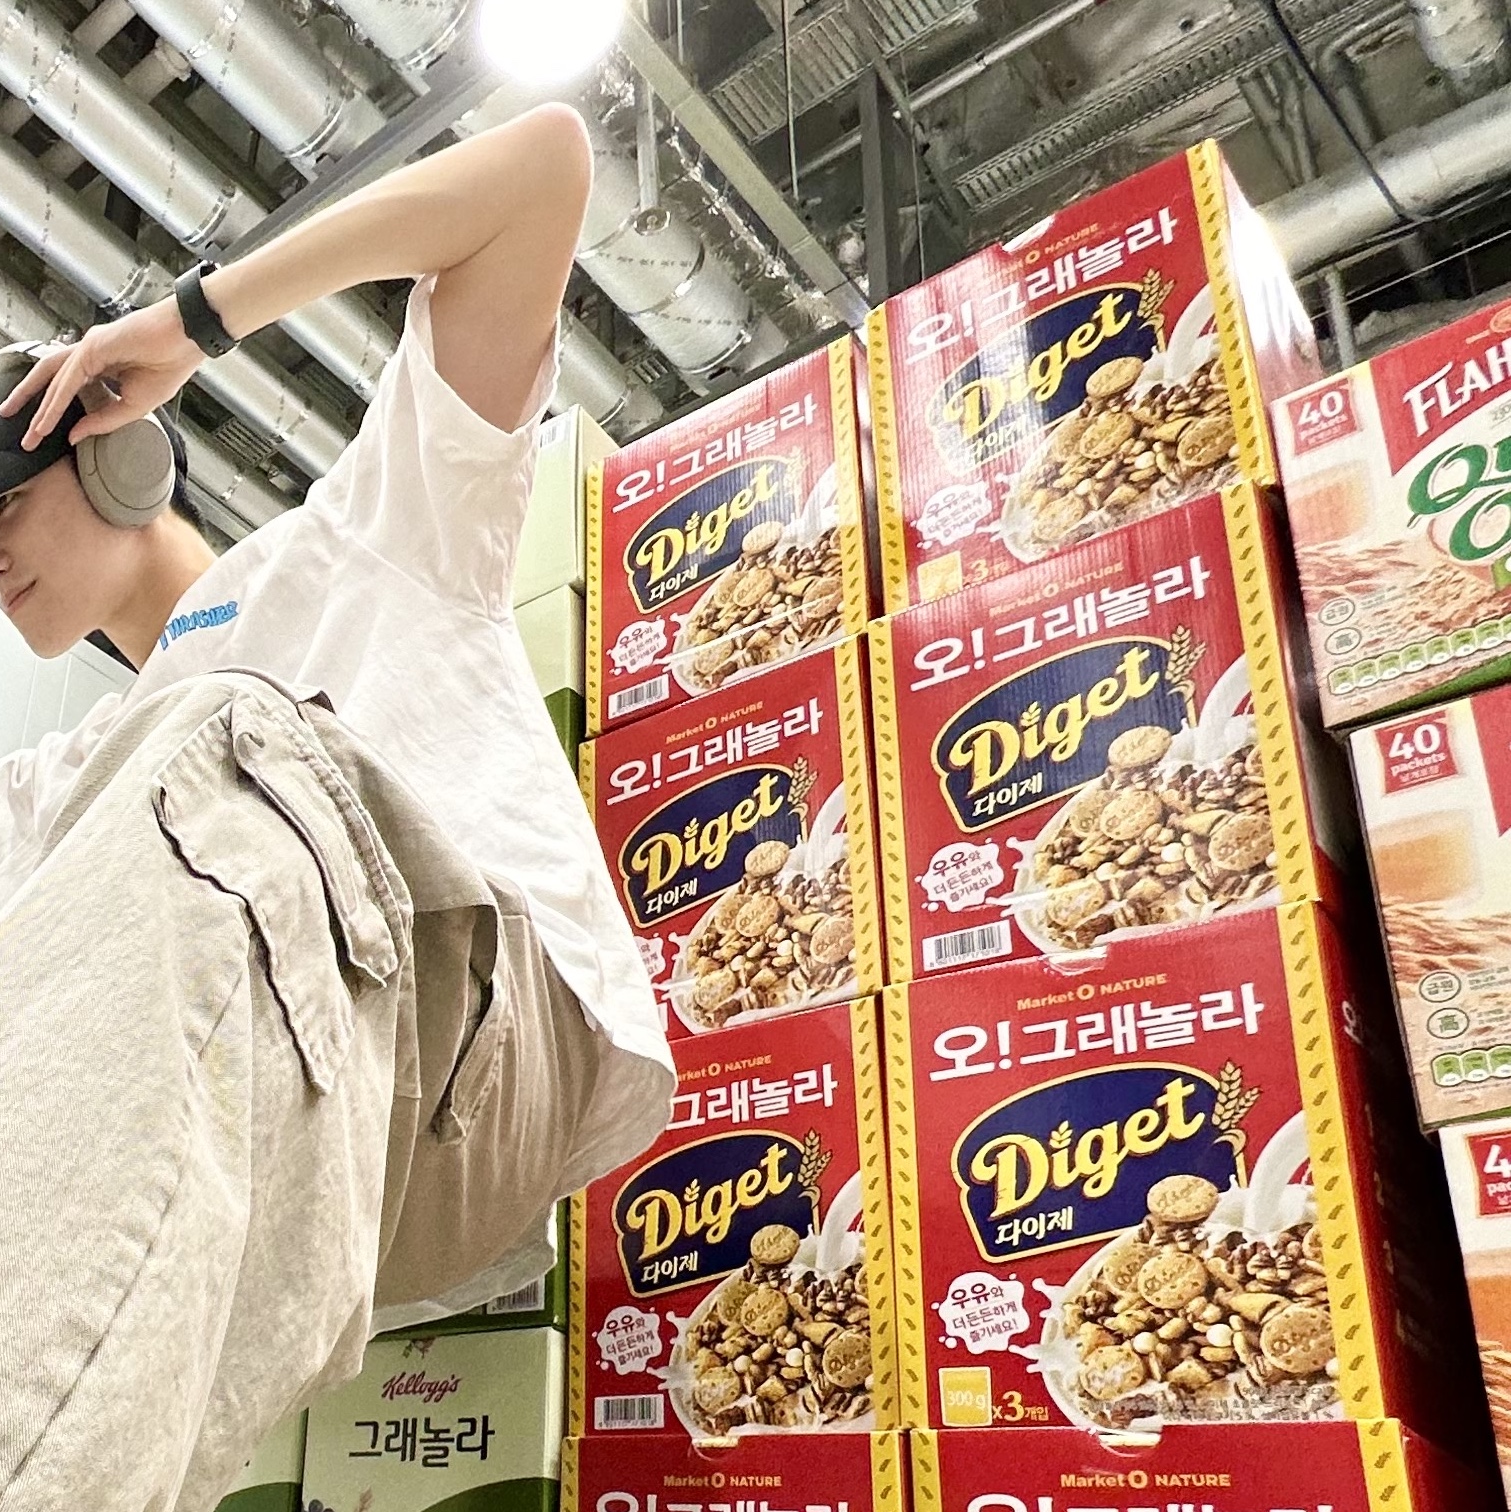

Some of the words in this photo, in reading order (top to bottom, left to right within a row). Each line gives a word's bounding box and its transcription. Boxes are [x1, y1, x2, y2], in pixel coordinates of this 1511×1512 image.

[1024, 249, 1040, 265] O
[1045, 222, 1099, 255] NATURE
[943, 292, 1133, 439] Diget
[1297, 391, 1343, 426] 40
[635, 464, 778, 589] Diget
[648, 565, 700, 603] 다이제
[1042, 582, 1060, 600] O
[159, 600, 239, 651] THRASHER
[665, 724, 704, 746] Market
[704, 716, 718, 730] O
[720, 701, 764, 723] NATURE
[948, 645, 1162, 798] Diget
[1388, 723, 1441, 760] 40
[1390, 752, 1446, 777] packets
[971, 771, 1044, 818] 다이제
[631, 772, 784, 900] Diget
[644, 877, 699, 917] 다이제
[1016, 992, 1078, 1012] Market
[1076, 983, 1095, 1001] O
[1099, 973, 1168, 995] NATURE
[707, 1062, 722, 1078] O
[725, 1055, 773, 1073] NATURE
[971, 1076, 1206, 1221] Diget
[626, 1143, 795, 1260] Diget
[994, 1206, 1075, 1247] 다이제
[641, 1251, 699, 1284] 다이제
[951, 1283, 1005, 1309] 우유와
[969, 1318, 1019, 1343] 즐기세요!
[381, 1371, 462, 1403] Kellogg's
[348, 1415, 496, 1469] 그래놀라
[663, 1474, 710, 1489] Market
[710, 1471, 726, 1489] O
[730, 1475, 782, 1488] NATURE
[1060, 1473, 1128, 1489] Market
[1127, 1470, 1148, 1489] O
[1154, 1473, 1232, 1487] NATURE
